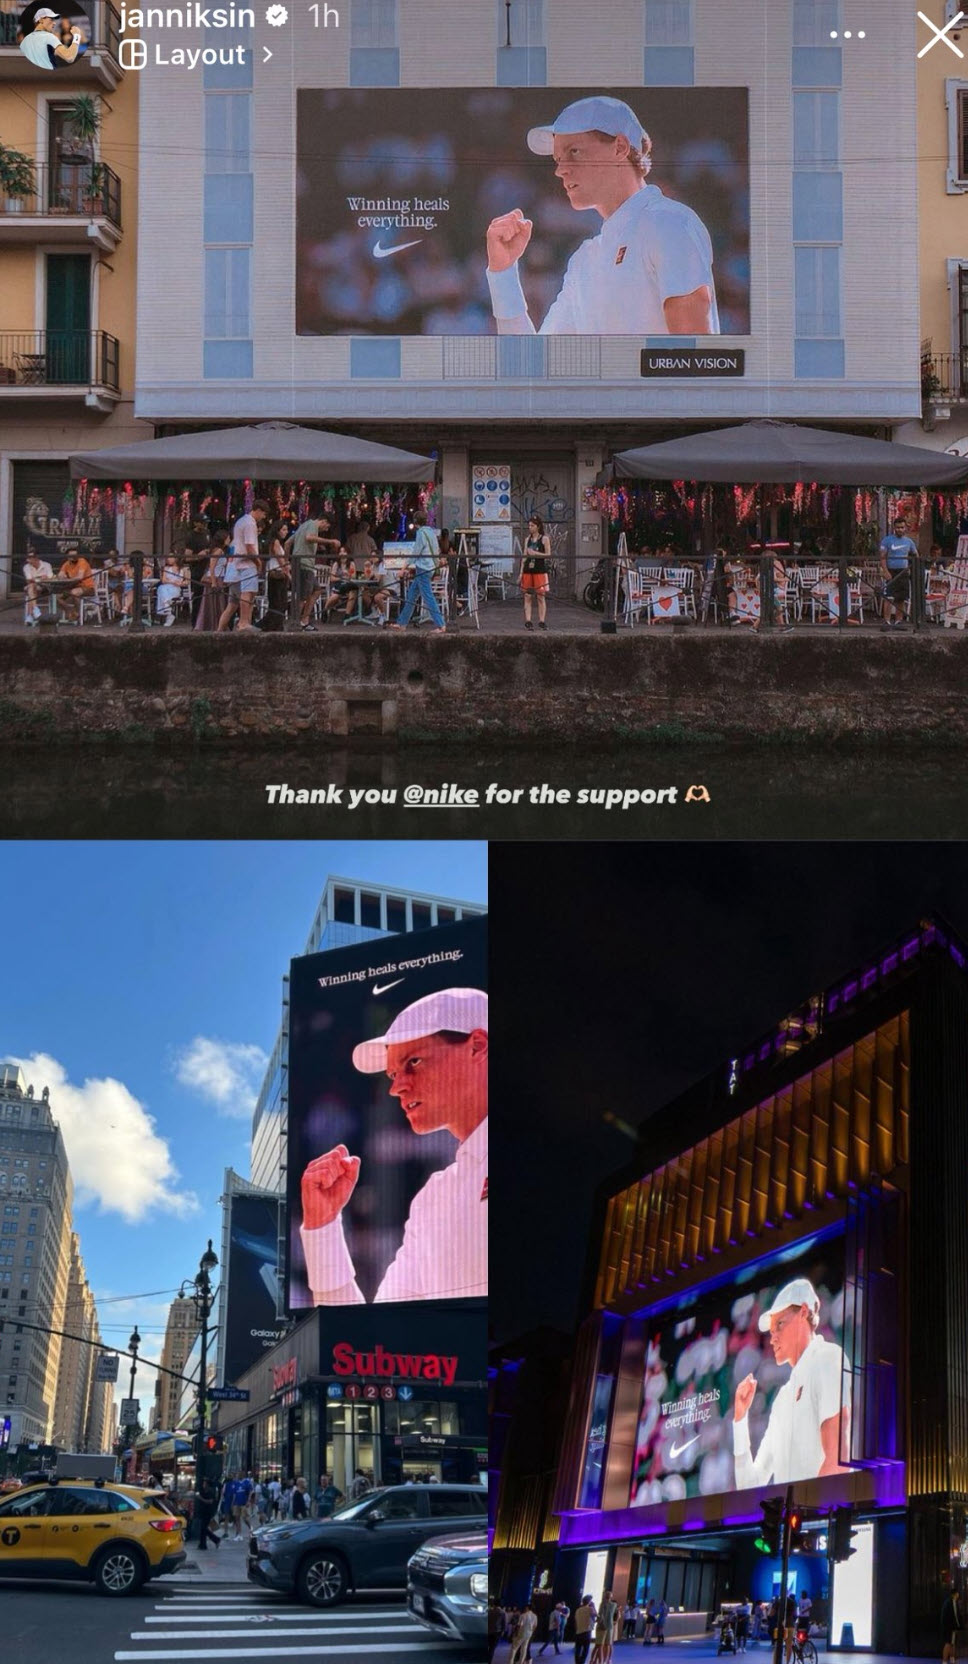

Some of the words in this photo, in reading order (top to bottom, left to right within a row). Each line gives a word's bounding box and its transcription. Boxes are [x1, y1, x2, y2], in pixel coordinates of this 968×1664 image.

[347, 197, 411, 214] Winning
[414, 197, 450, 211] heals
[357, 213, 438, 231] everything.
[649, 358, 691, 369] URBAN
[694, 357, 737, 369] VISION
[318, 969, 366, 987] Winning
[368, 963, 397, 977] heals
[398, 949, 464, 970] everything.
[250, 1329, 280, 1339] Galaxy
[332, 1342, 458, 1386] Subway
[367, 1387, 376, 1398] 2
[384, 1388, 393, 1399] 3
[661, 1396, 697, 1415] Winning
[698, 1388, 720, 1405] heals
[123, 1409, 136, 1418] 25
[420, 1436, 446, 1445] Subway
[6, 1530, 16, 1544] T
